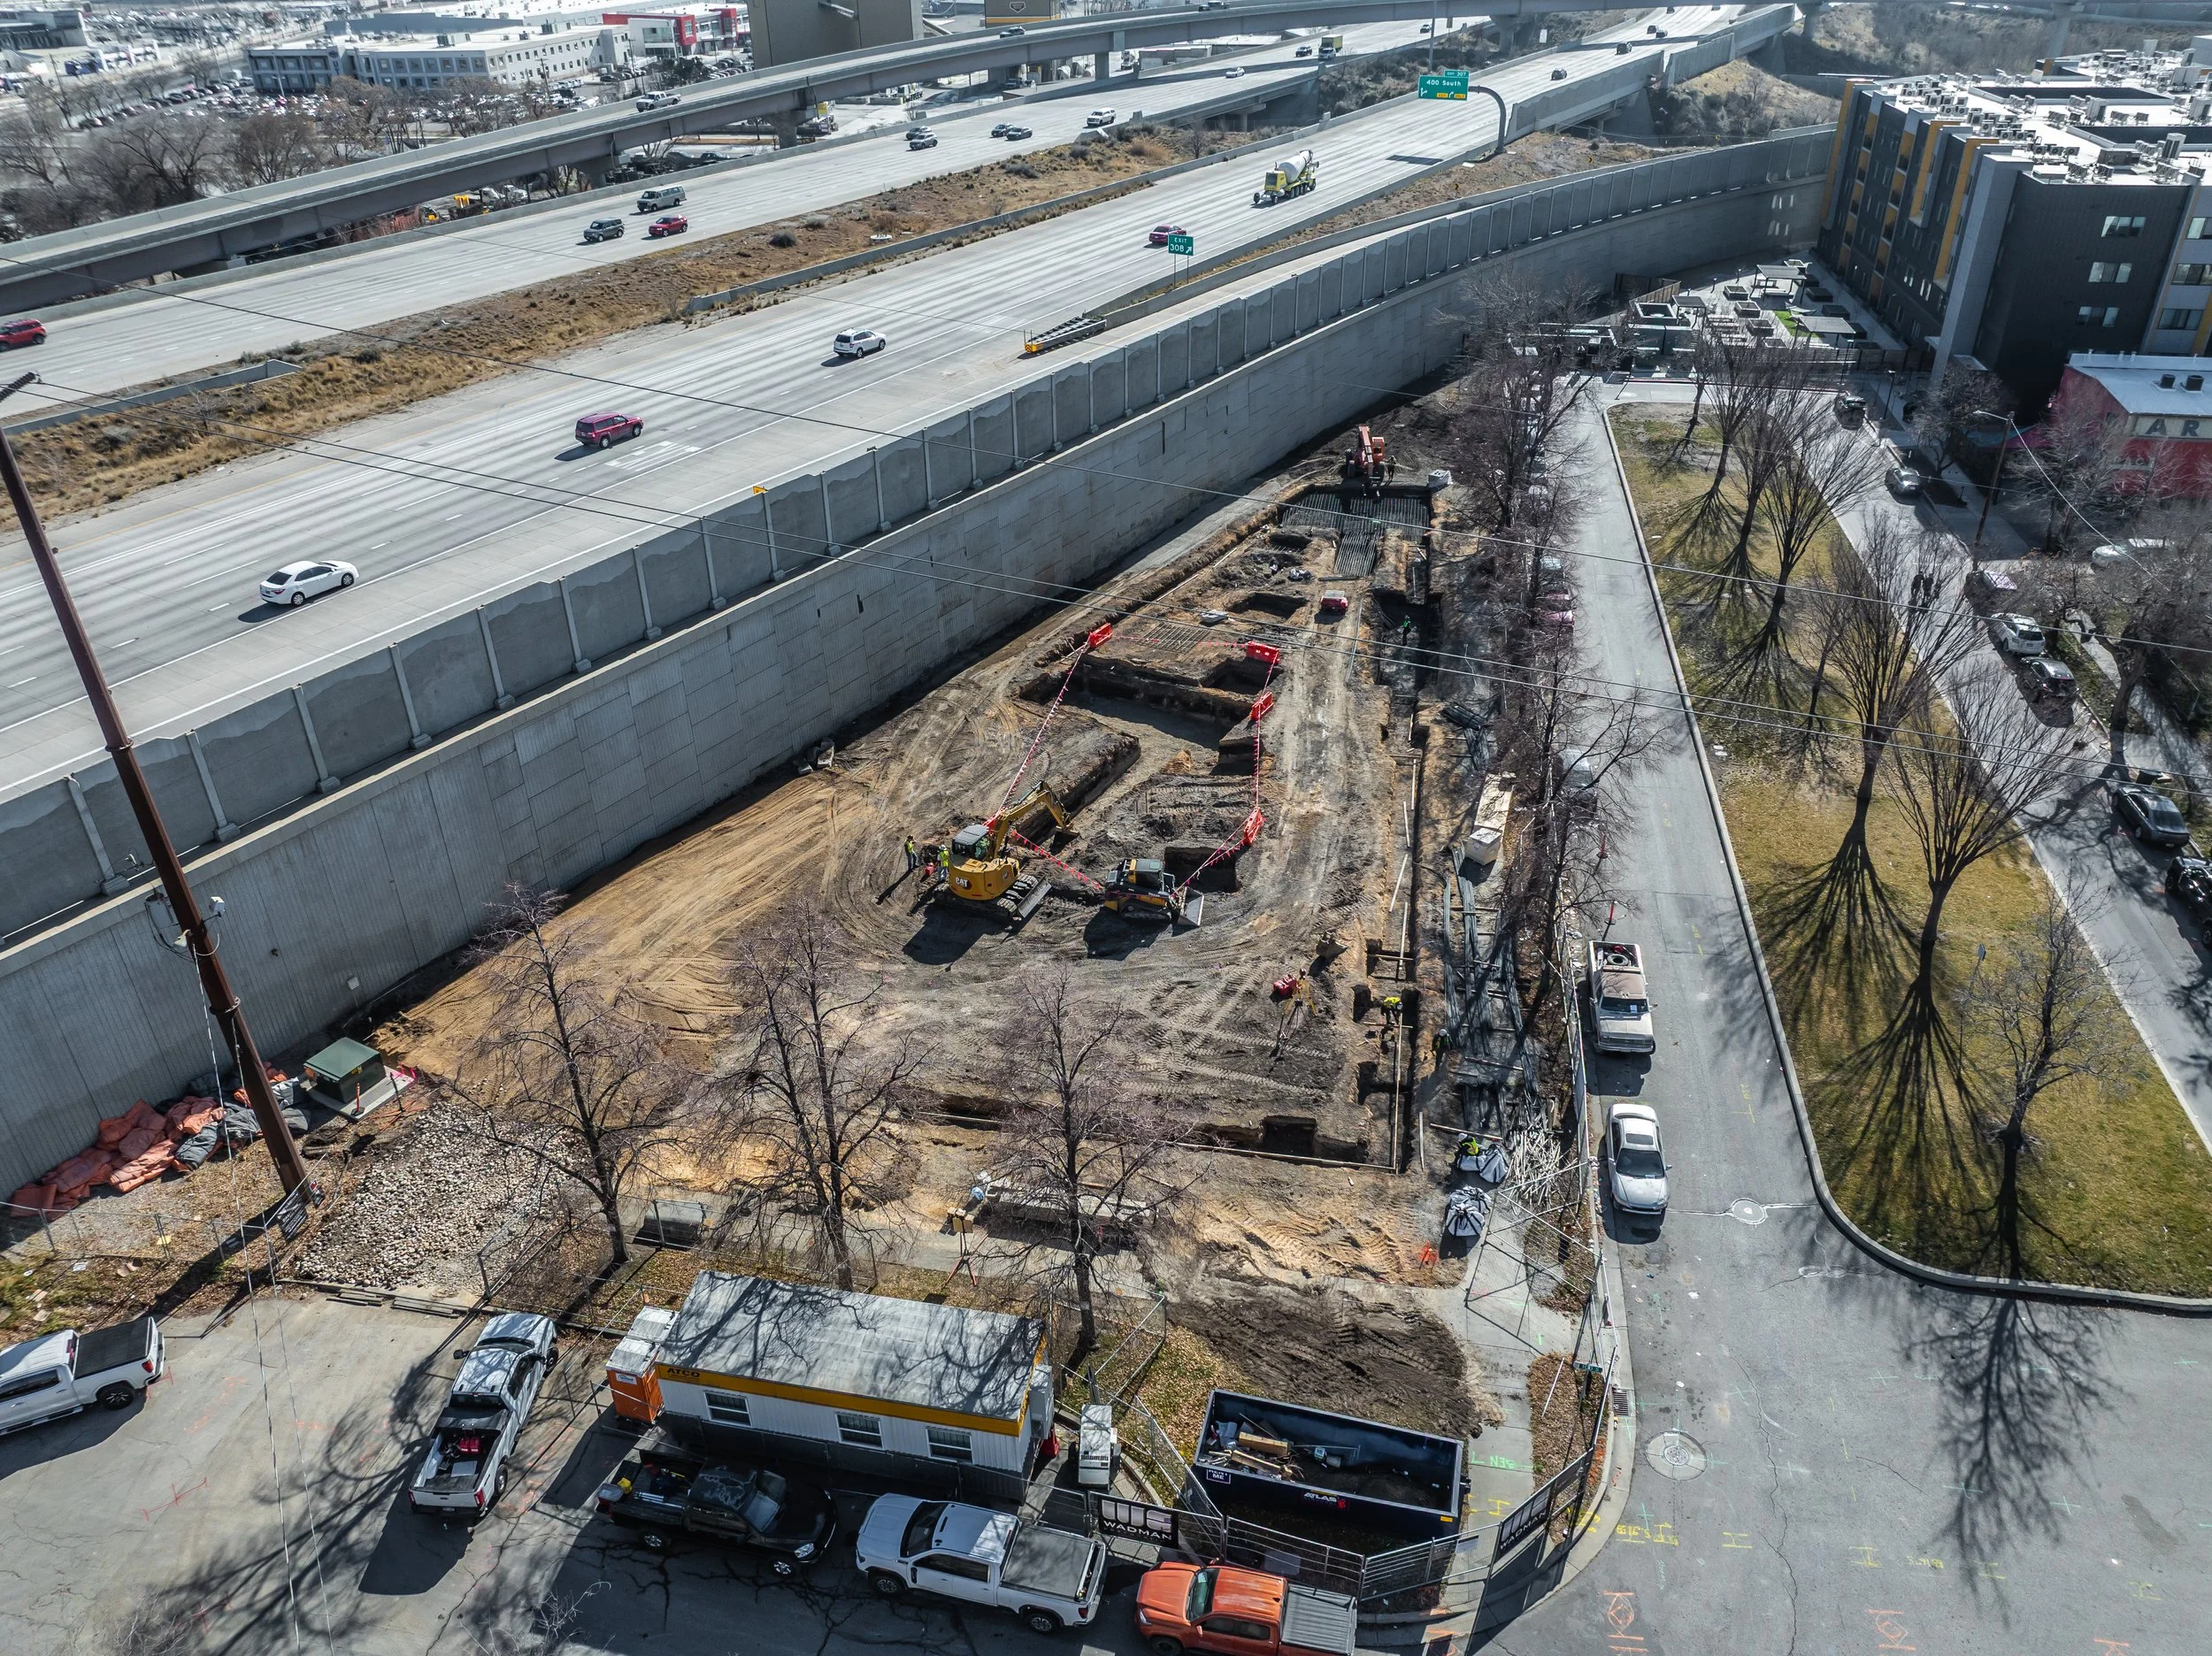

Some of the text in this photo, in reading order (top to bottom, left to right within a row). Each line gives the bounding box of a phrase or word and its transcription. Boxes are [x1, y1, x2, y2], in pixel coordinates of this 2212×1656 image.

[956, 877, 969, 888] CAT
[667, 1368, 701, 1378] ATCO
[1303, 1492, 1337, 1502] ATLAS
[1103, 1520, 1172, 1540] WADMAN
[1500, 1508, 1547, 1550] WADMAN
